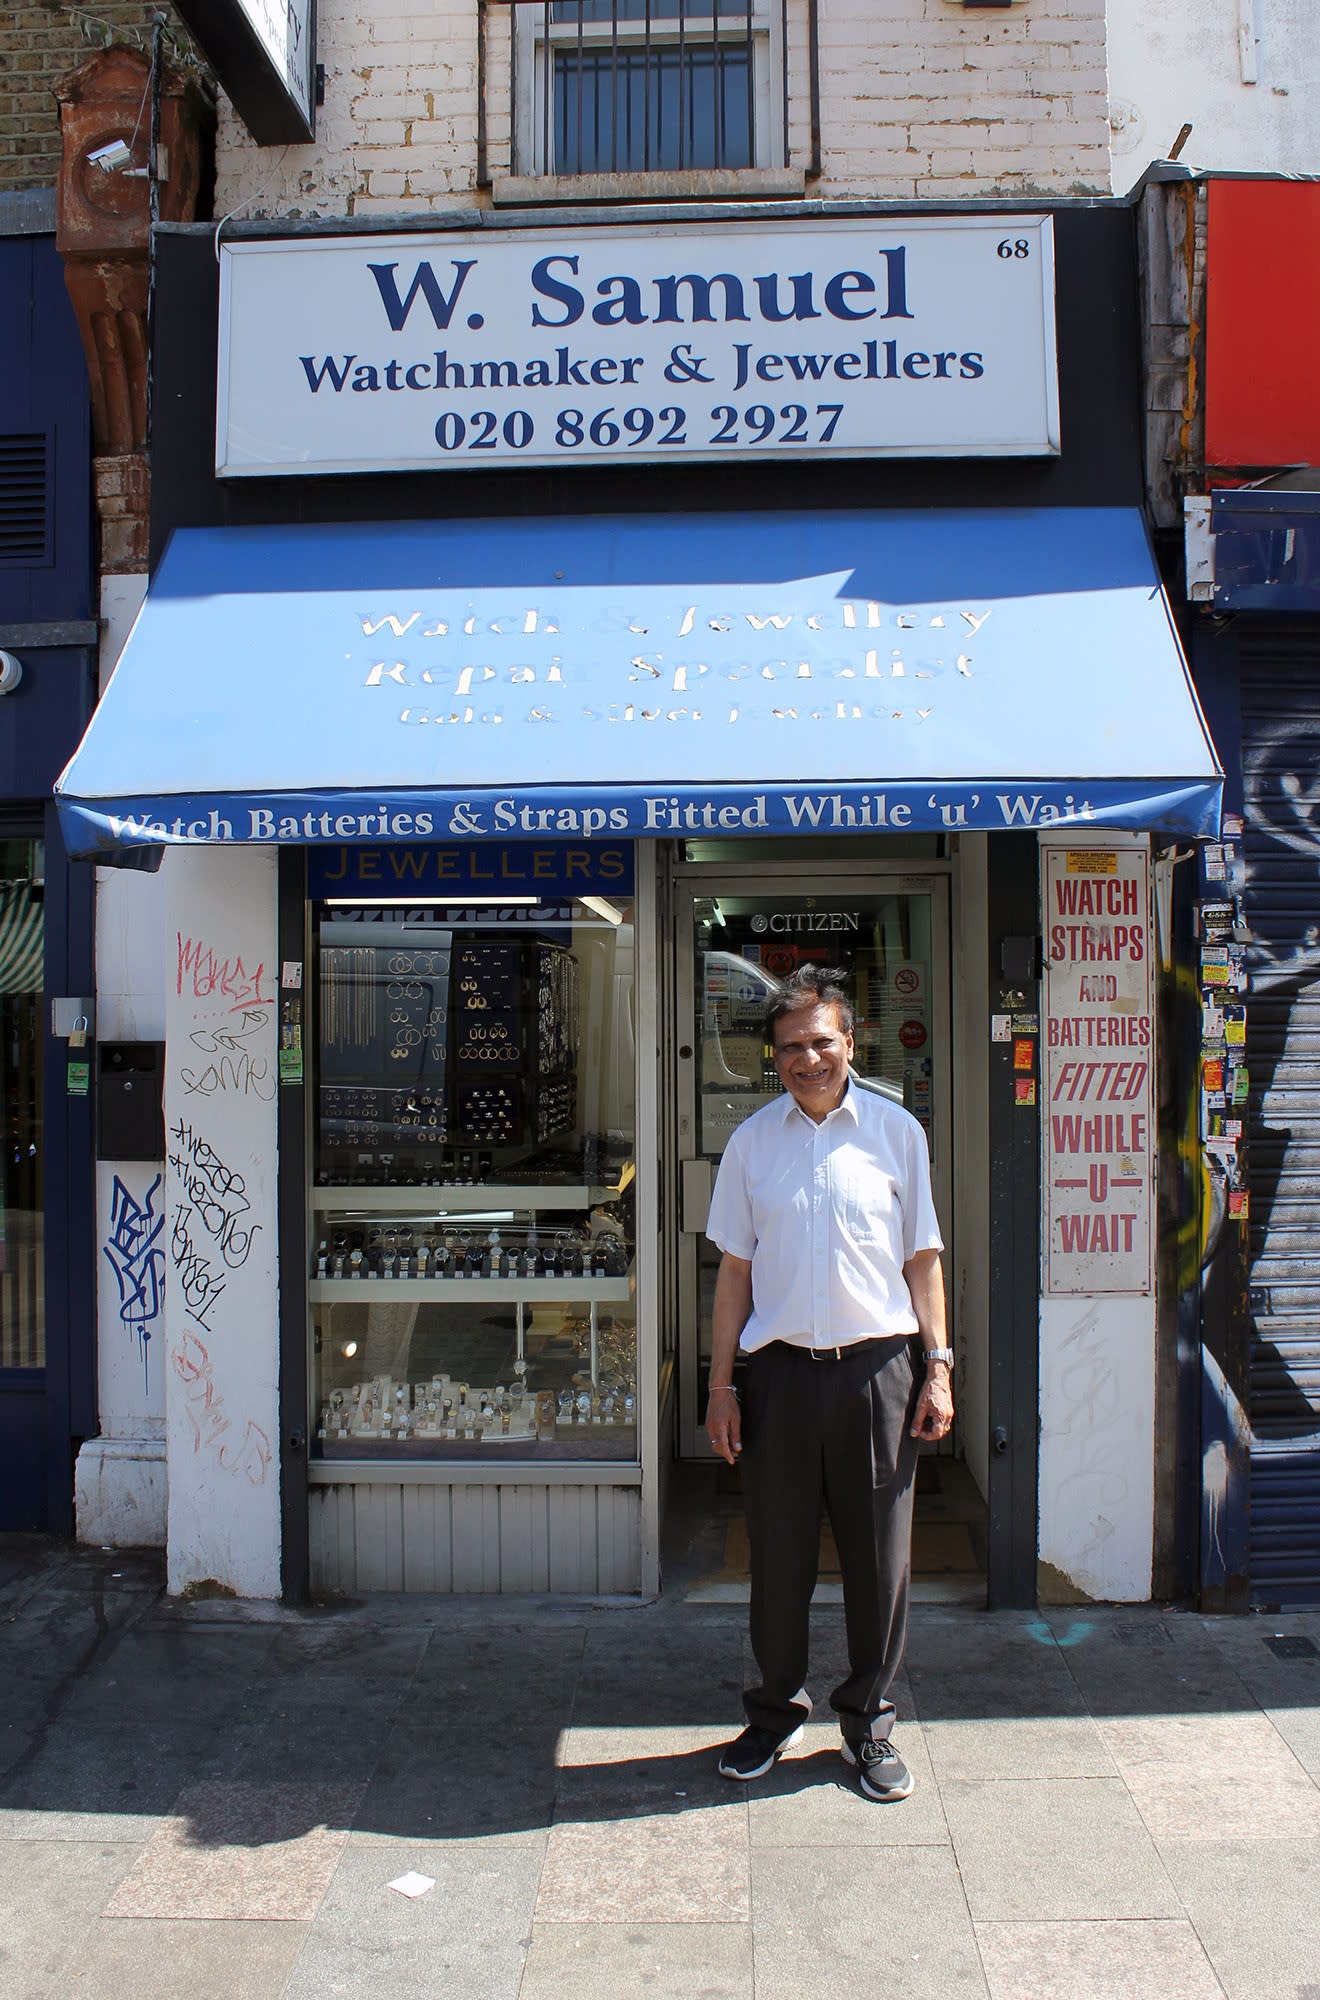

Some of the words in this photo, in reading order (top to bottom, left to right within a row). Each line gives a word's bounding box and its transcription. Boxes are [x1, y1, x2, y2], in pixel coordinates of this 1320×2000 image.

[997, 240, 1028, 258] 68
[367, 260, 484, 331] W.
[532, 246, 914, 327] Samuel
[299, 347, 644, 392] Watchmaker
[664, 345, 714, 383] &
[733, 340, 983, 390] Jewellers
[435, 411, 533, 450] 020
[556, 407, 686, 452] 8692
[710, 405, 843, 448] 2927
[107, 809, 234, 841] Watch
[248, 807, 432, 839] Batteries
[449, 804, 487, 834] &
[495, 800, 628, 837] Straps
[644, 796, 766, 829] Fitted
[783, 795, 911, 827] While
[999, 795, 1096, 825] Wait
[323, 847, 625, 879] JEWELLERS
[1056, 879, 1138, 915] WATCH
[770, 912, 860, 933] CITIZEN
[1052, 925, 1143, 961] STRAPS
[1079, 975, 1117, 1002] AND
[1047, 1016, 1150, 1047] BATTERIES
[1053, 1062, 1147, 1101] FITTED
[1052, 1114, 1145, 1153] WHILE
[1060, 1214, 1137, 1252] WAIT
